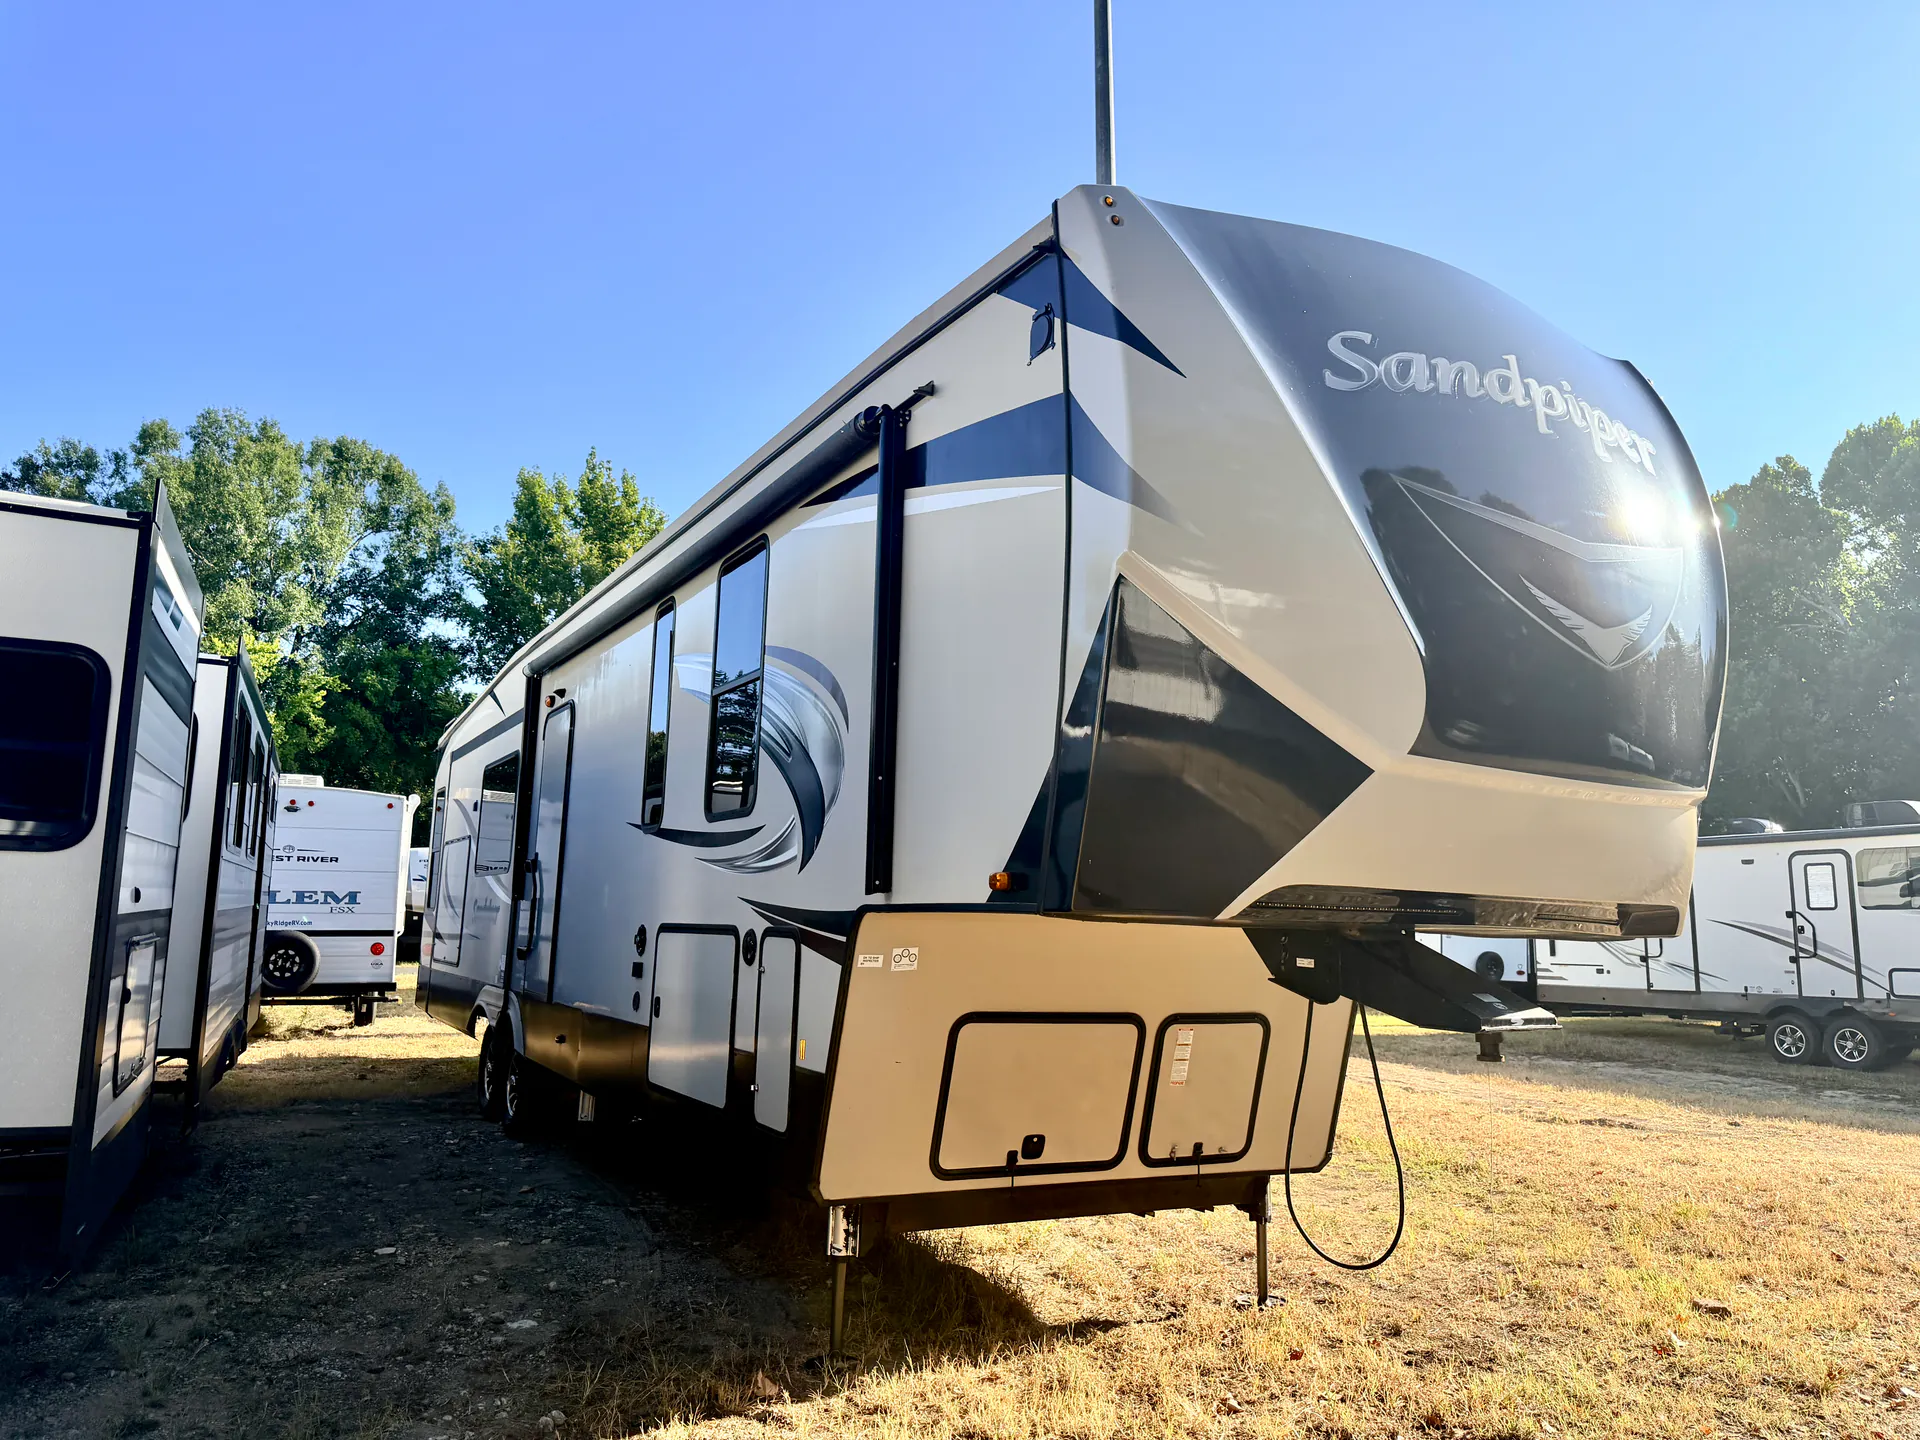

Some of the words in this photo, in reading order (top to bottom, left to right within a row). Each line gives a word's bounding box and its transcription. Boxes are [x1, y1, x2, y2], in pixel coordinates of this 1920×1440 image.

[1323, 330, 1657, 476] Sandpiper
[296, 855, 339, 863] RIVER
[268, 890, 361, 905] LEM
[329, 906, 356, 914] FSX
